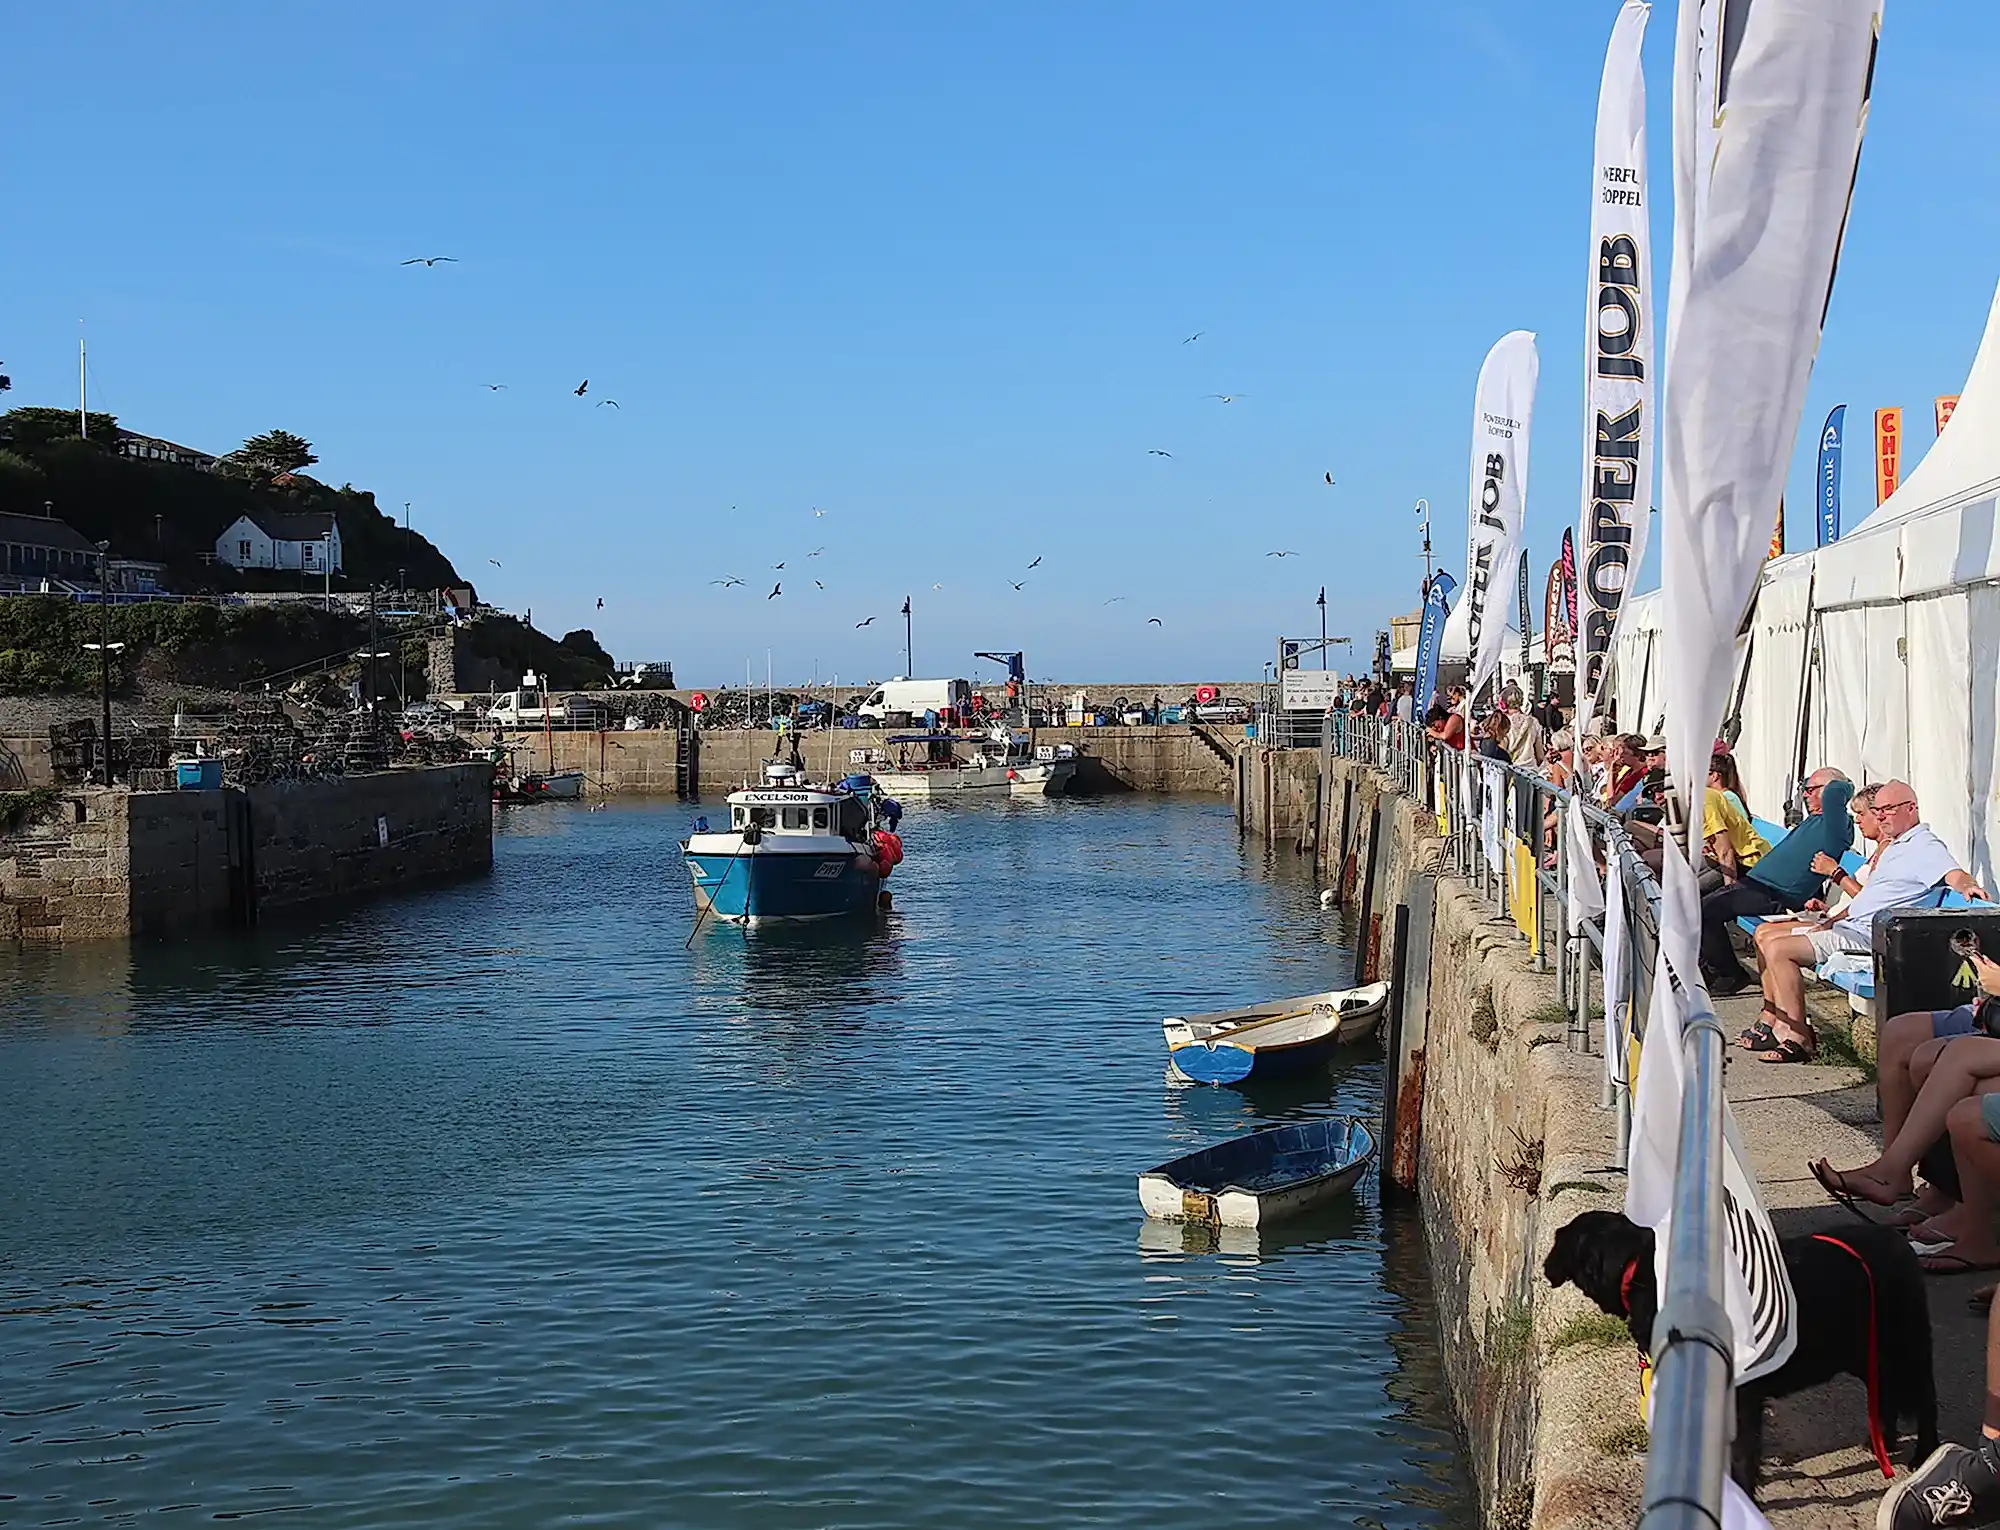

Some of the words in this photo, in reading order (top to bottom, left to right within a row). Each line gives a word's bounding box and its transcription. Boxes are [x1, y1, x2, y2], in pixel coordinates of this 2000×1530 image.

[1602, 187, 1642, 207] OPPE
[1597, 233, 1644, 383] JOB
[1479, 451, 1507, 536] JOB
[745, 793, 809, 801] EXCELSIOR
